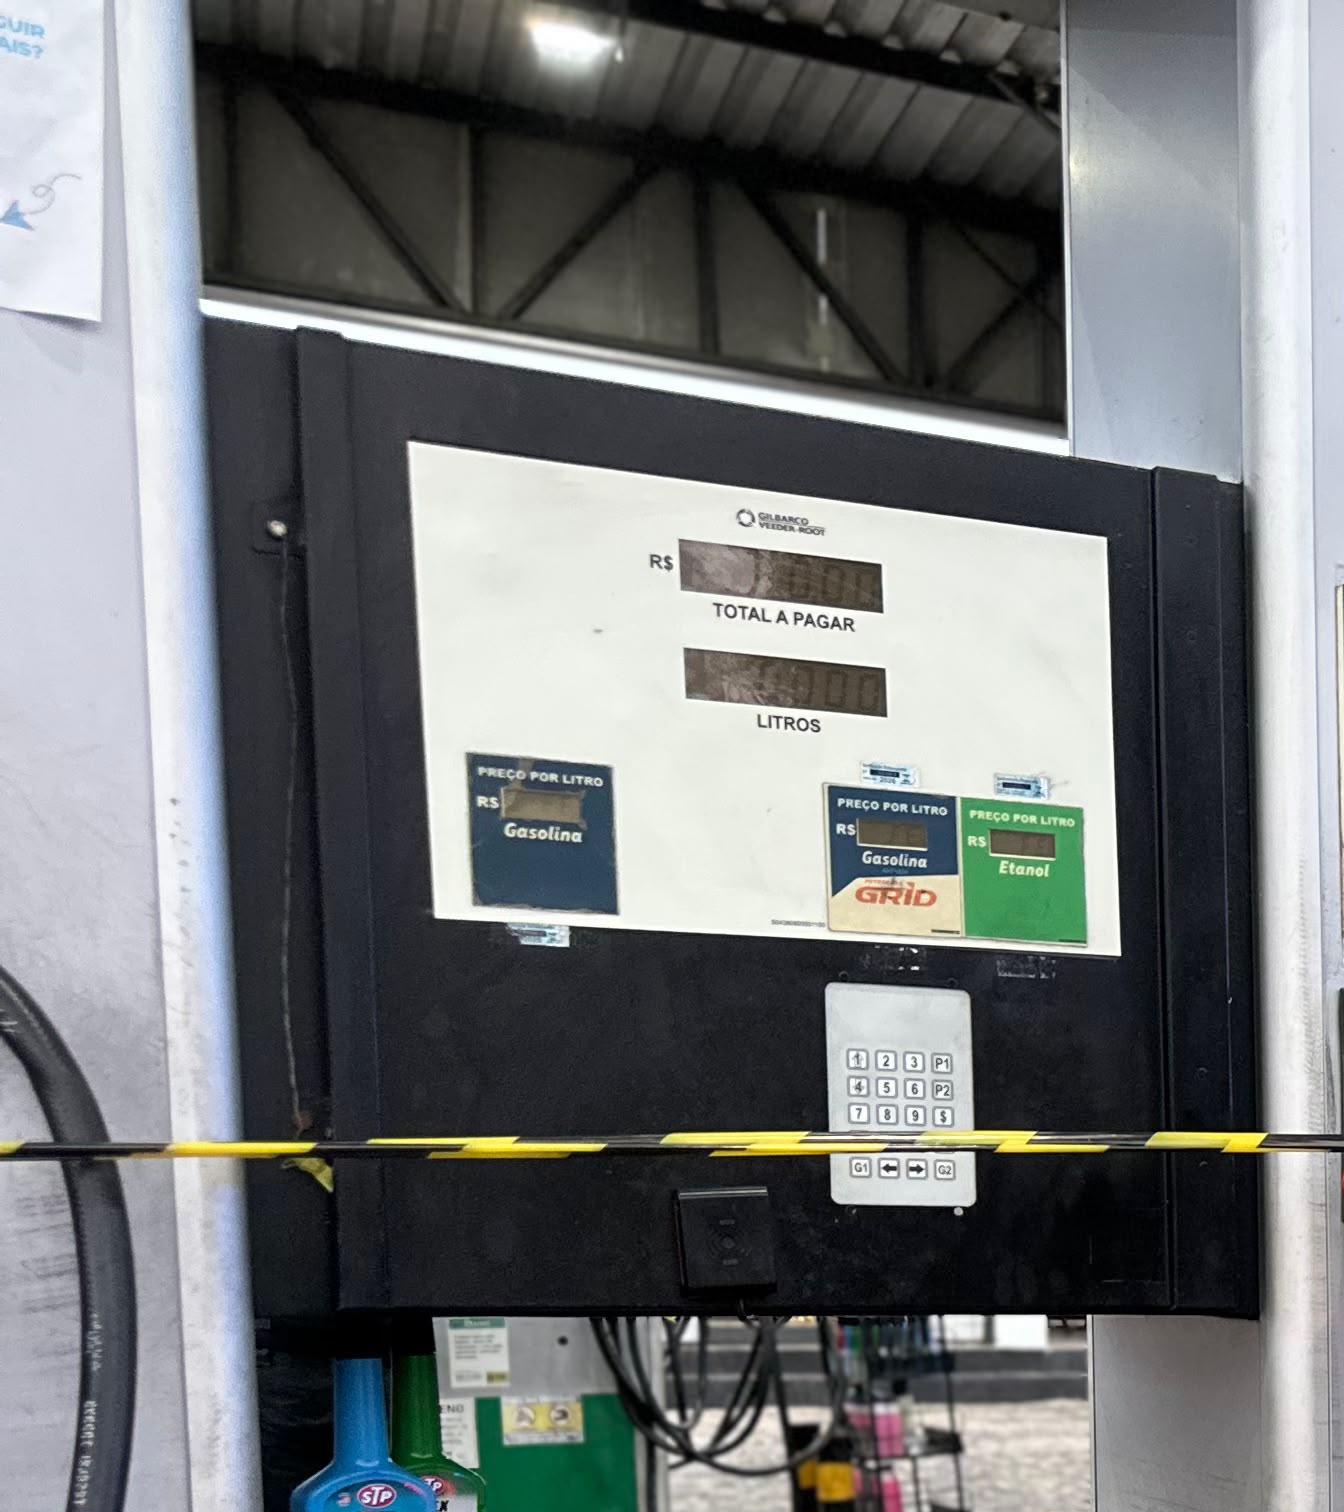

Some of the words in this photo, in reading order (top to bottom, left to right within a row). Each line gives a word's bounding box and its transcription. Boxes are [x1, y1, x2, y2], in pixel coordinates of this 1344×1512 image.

[758, 511, 809, 527] GILBARCO
[649, 554, 674, 571] R$
[712, 602, 772, 624] TOTAL
[775, 609, 789, 625] A
[793, 611, 856, 633] PAGAR
[757, 713, 822, 734] LITROS
[477, 766, 526, 782] PREÇO
[530, 771, 559, 784] POR
[562, 774, 604, 788] LITRO
[837, 798, 879, 812] PREÇO
[883, 801, 909, 813] POR
[911, 804, 948, 817] LITRO
[969, 809, 1010, 823] PREÇO
[1013, 812, 1038, 825] POR
[1040, 815, 1076, 828] LITRO
[504, 822, 583, 844] Gasolina
[861, 850, 928, 870] Gasolina
[998, 860, 1050, 878] Etanol
[855, 881, 937, 908] GRID
[882, 1055, 890, 1067] 2
[910, 1056, 918, 1068] 3
[935, 1057, 949, 1070] P1
[883, 1082, 890, 1094] 5
[911, 1083, 918, 1095] 6
[935, 1084, 950, 1097] P2
[884, 1109, 891, 1121] 8
[912, 1110, 919, 1122] 9
[854, 1161, 868, 1173] G1
[937, 1164, 951, 1176] G2
[361, 1487, 394, 1506] STP
